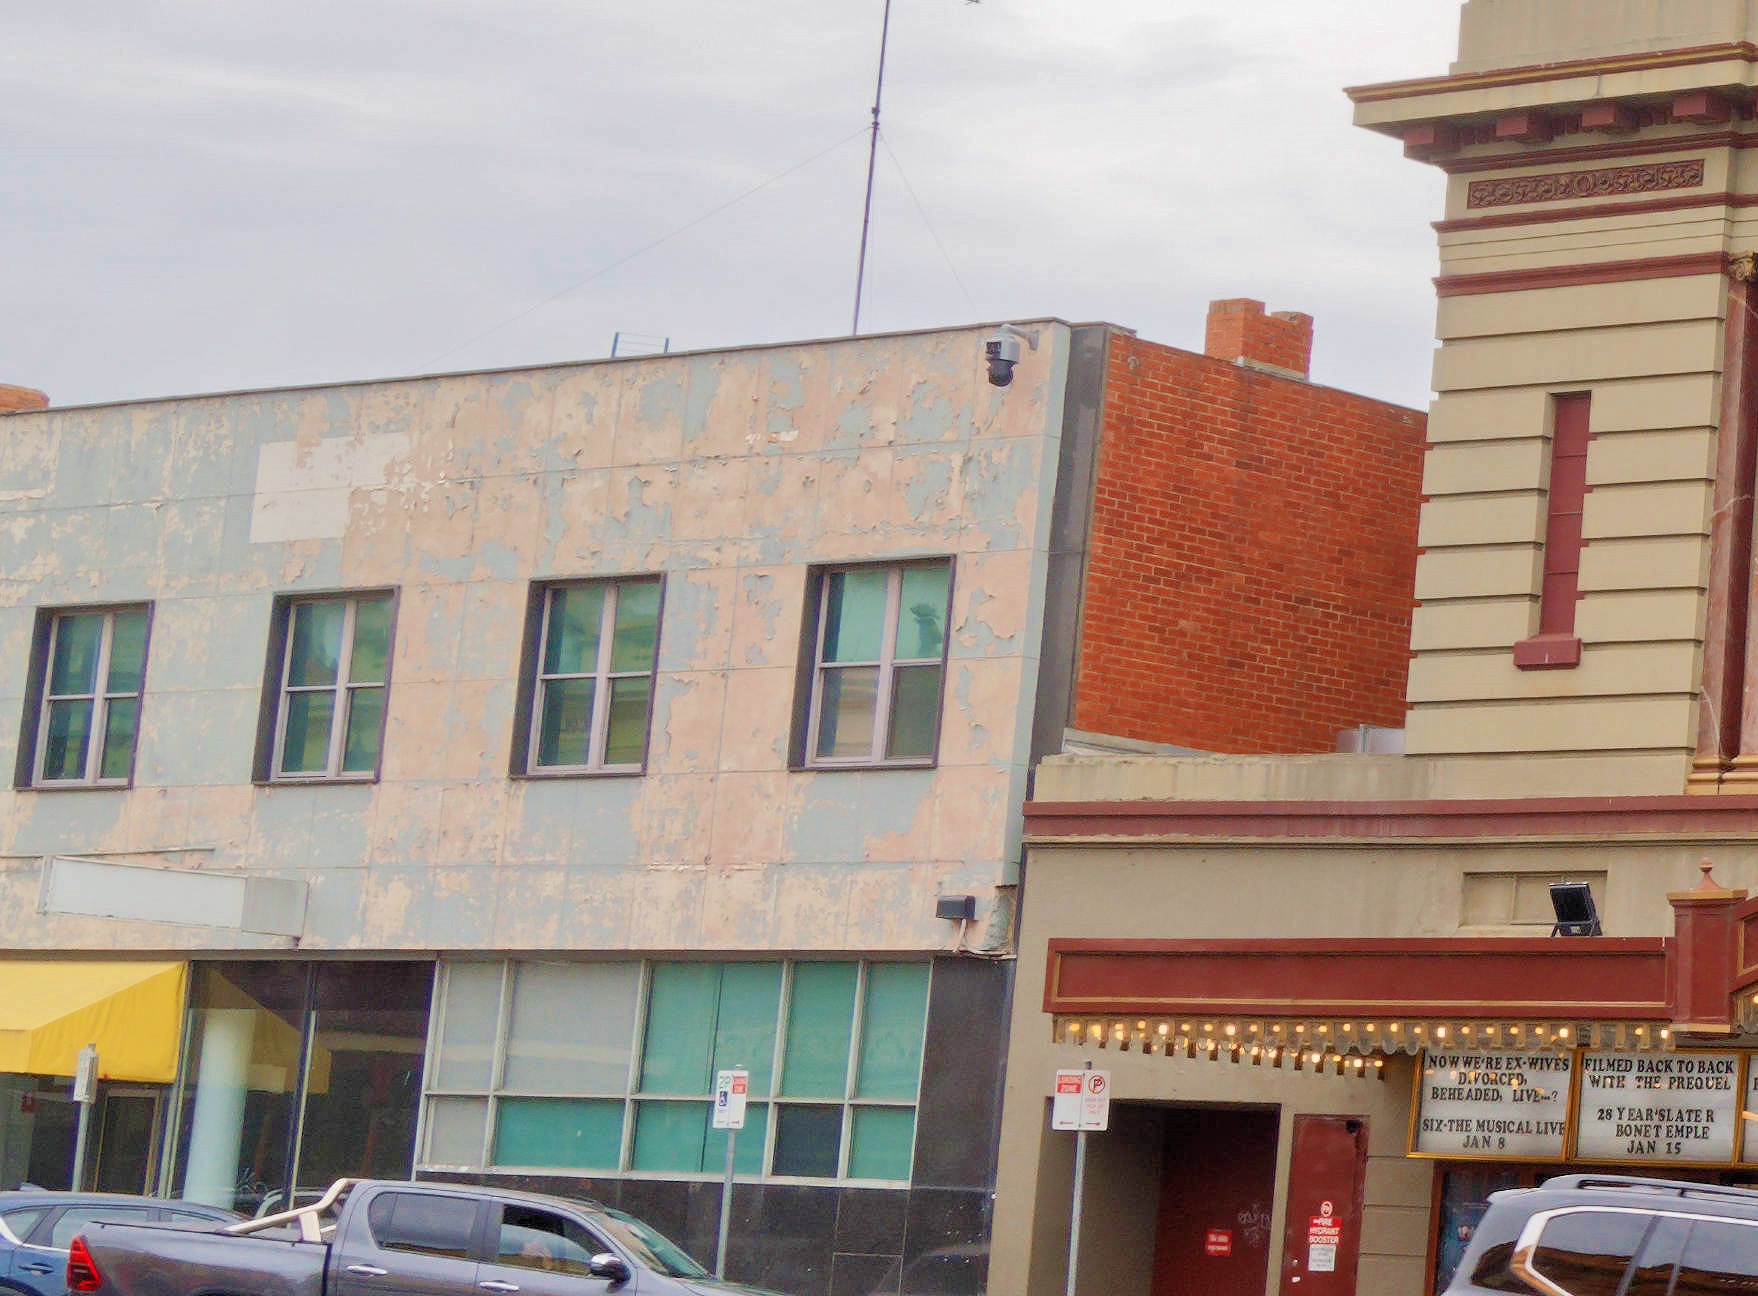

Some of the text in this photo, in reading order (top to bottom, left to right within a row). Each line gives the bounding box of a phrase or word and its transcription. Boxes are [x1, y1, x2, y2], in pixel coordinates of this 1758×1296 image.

[1429, 1055, 1459, 1068] NOW
[1463, 1056, 1502, 1070] WE'RE
[1585, 1058, 1734, 1075] FILMED BACK TO BACK
[1589, 1074, 1731, 1091] WITH THE PREQUEL
[1597, 1108, 1613, 1121] 28
[1476, 1119, 1533, 1134] MUSICAL
[1462, 1135, 1506, 1149] JAN 8
[1627, 1140, 1682, 1154] JAN 15
